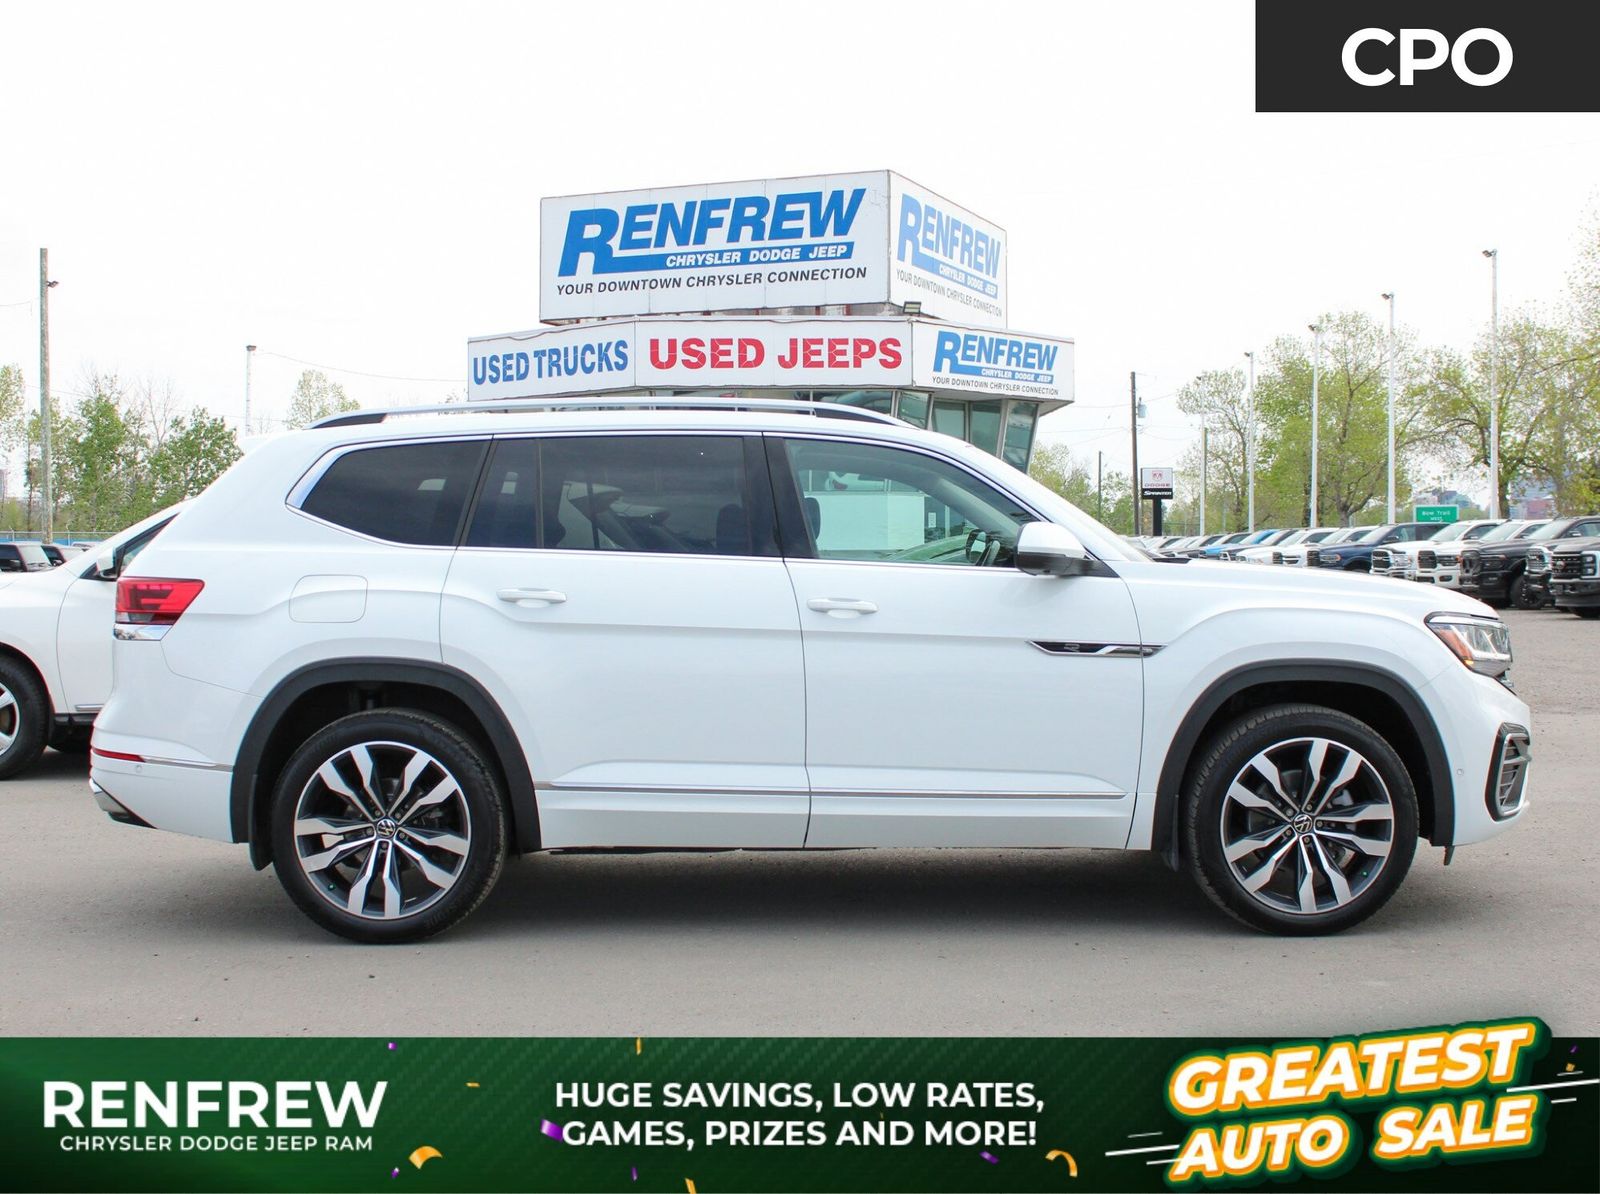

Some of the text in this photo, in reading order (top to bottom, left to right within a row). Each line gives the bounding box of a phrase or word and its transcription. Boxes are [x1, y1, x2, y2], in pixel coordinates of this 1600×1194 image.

[558, 188, 866, 277] RENFREW
[897, 193, 1001, 278] RENFREW
[666, 245, 848, 268] CHRYSLER DODGE JEEP
[557, 266, 867, 296] YOUR DOWNTOWN CHRYSLER CONNECTION
[939, 263, 966, 284] CHRYSLER
[896, 269, 1002, 317] YOUR DOWNTOWN CHRYSLER CONNECTION
[473, 339, 629, 386] USED TRUCKS
[649, 337, 902, 370] USED JEEPS
[933, 330, 1058, 372] RENFREW
[932, 376, 1059, 396] YOUR DOWNTOWN CHRYSLER CONNECTION
[981, 367, 1052, 383] CHRYSLER DODGE JEEP
